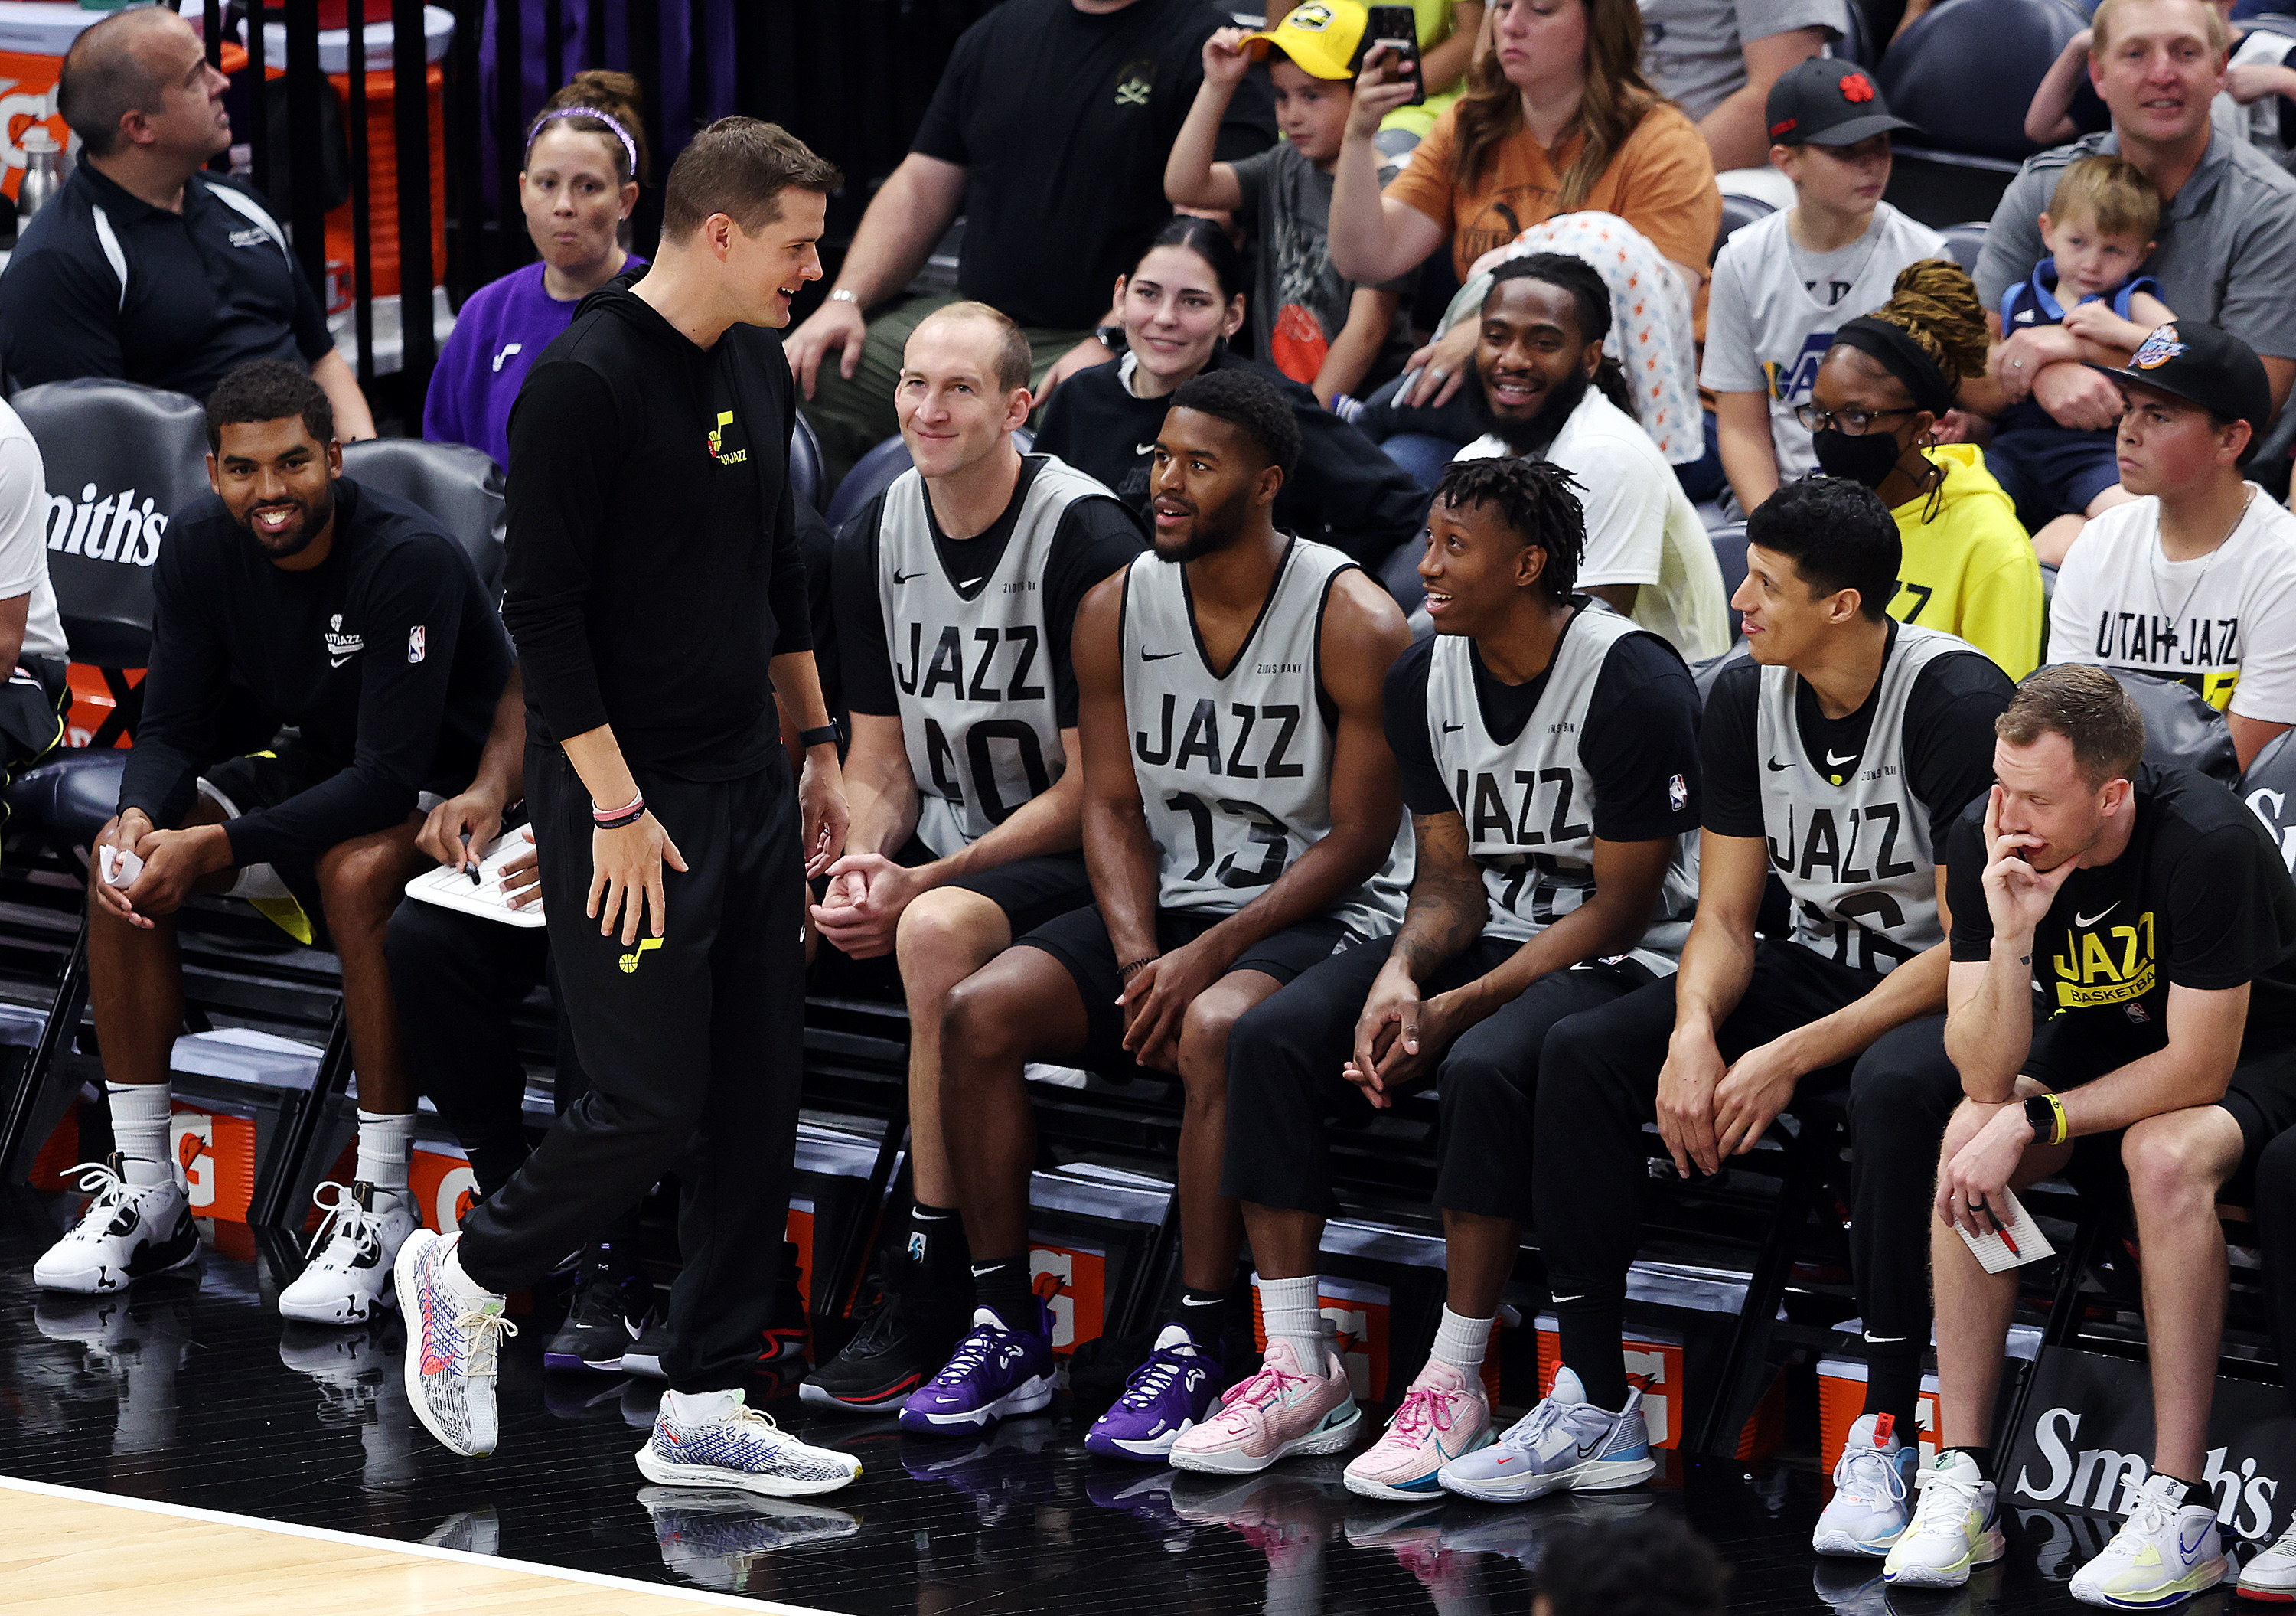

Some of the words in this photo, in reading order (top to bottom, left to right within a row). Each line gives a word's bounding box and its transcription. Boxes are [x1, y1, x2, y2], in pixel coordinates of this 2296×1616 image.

[729, 449, 748, 464] JAZZ
[44, 482, 169, 567] mith's
[896, 622, 1045, 701] JAZZ
[2095, 610, 2170, 664] UTAH
[1136, 694, 1303, 779] JAZZ
[1165, 791, 1289, 889] 13
[1456, 767, 1590, 844] JAZZ
[1767, 803, 1916, 883] JAZZ
[2070, 970, 2156, 1004] BASKETBA
[2014, 1407, 2278, 1539] Smh's
